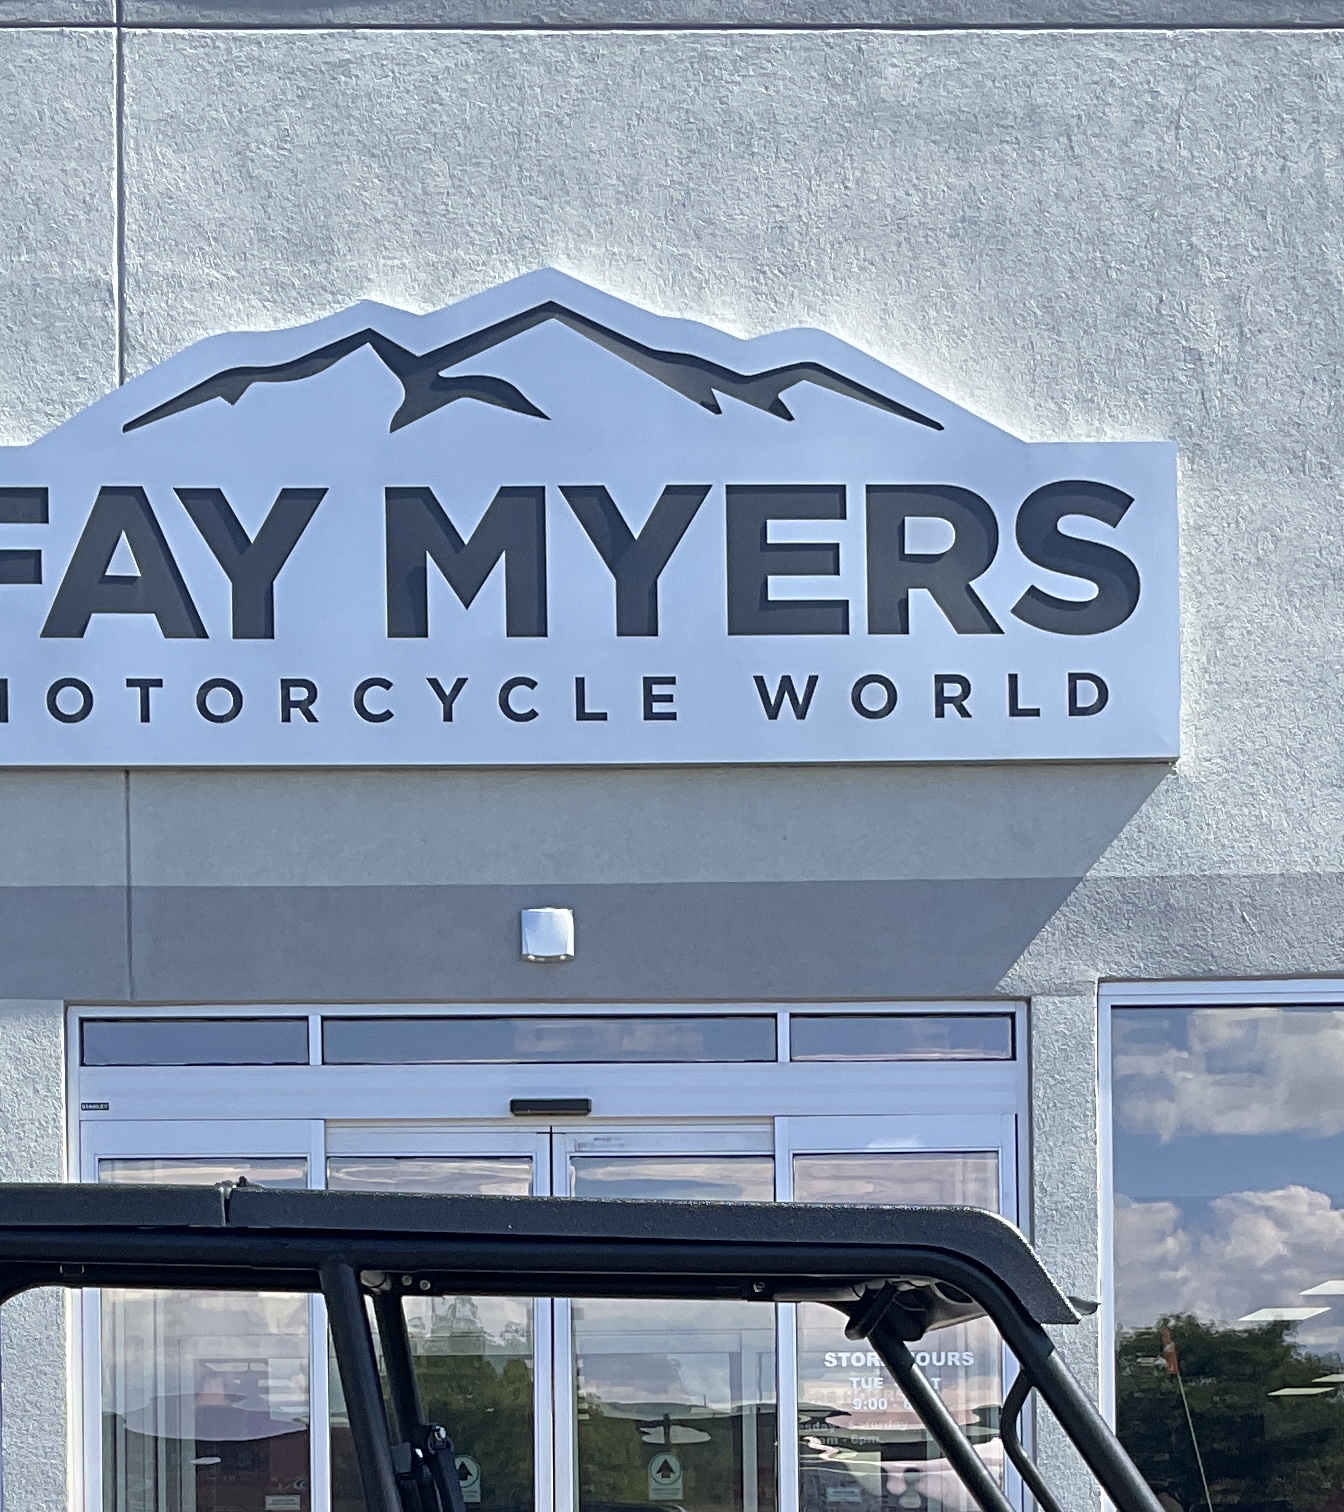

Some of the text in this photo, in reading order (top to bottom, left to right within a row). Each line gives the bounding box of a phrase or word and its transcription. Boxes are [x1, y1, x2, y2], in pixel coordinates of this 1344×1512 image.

[383, 480, 1142, 639] MYERS
[753, 672, 1110, 720] WORLD
[824, 1351, 975, 1367] STOR OURS
[849, 1377, 884, 1390] TUE
[852, 1397, 888, 1410] 9:00
